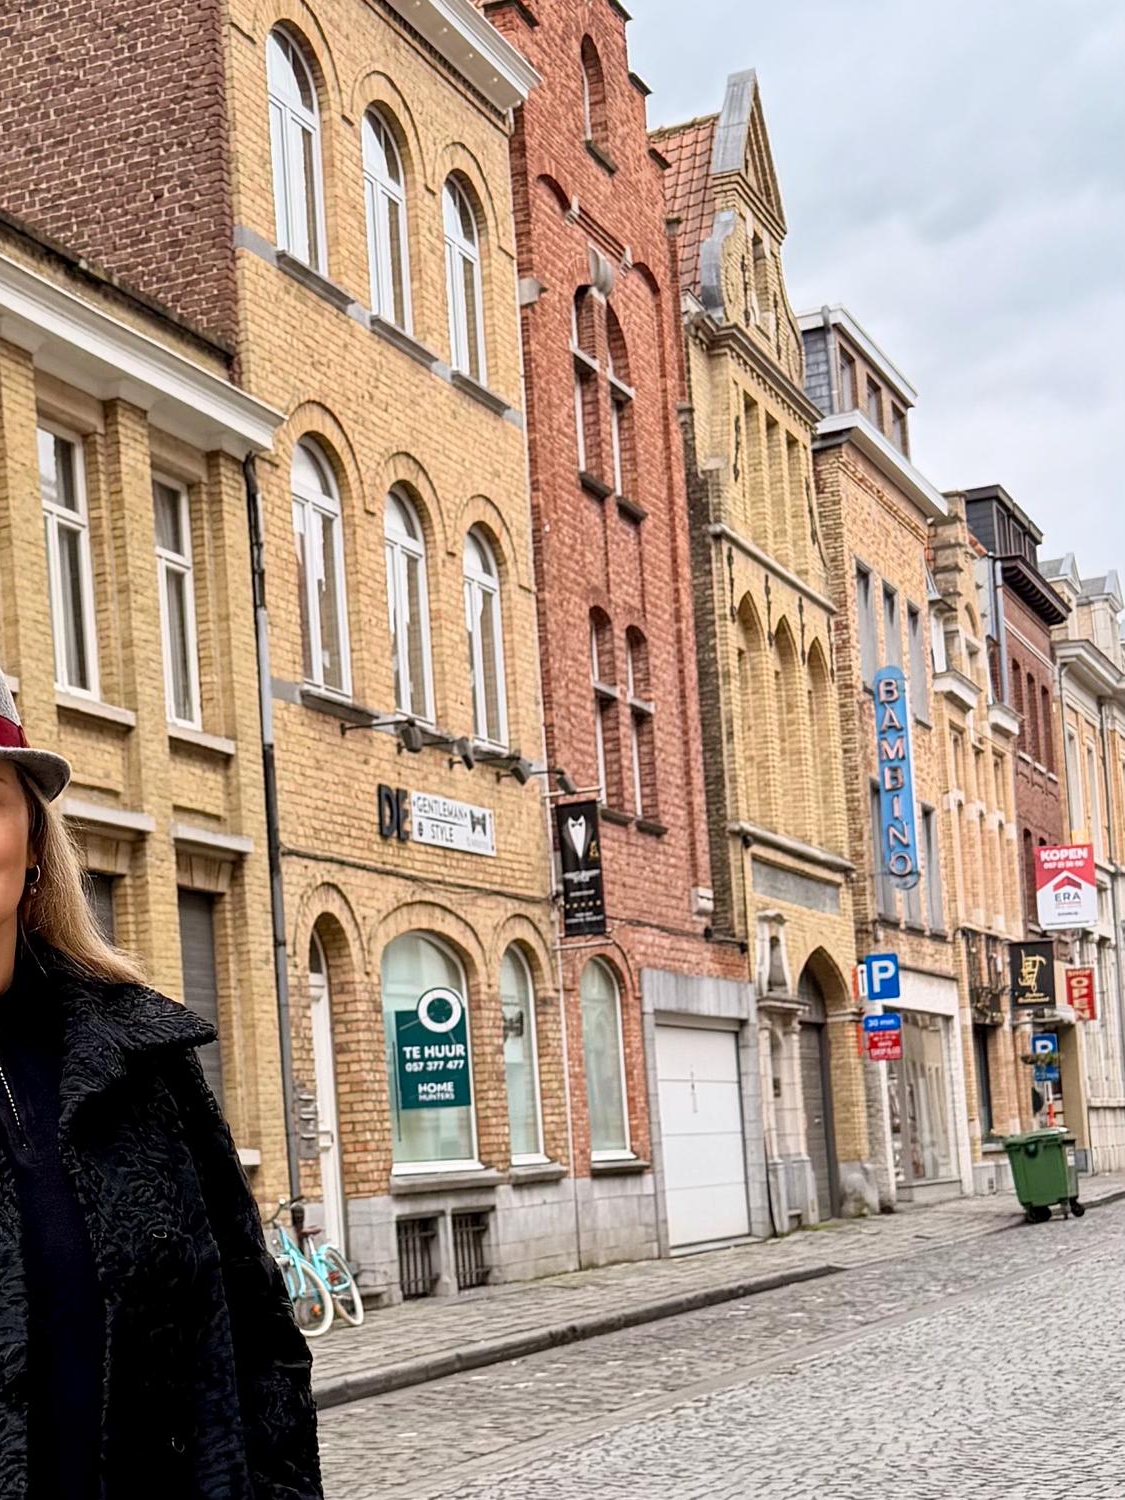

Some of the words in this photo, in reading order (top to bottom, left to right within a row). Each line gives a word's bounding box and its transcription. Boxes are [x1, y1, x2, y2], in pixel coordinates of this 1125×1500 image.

[878, 679, 911, 876] BAMBINO
[377, 783, 409, 842] DE
[416, 796, 465, 820] GENTLEMAN
[431, 823, 454, 843] STYLE
[1040, 847, 1088, 862] KOPEN
[1054, 891, 1081, 902] ERA
[871, 960, 896, 993] P
[1070, 976, 1091, 1021] OPEN
[403, 1046, 421, 1059] TE
[424, 1044, 465, 1058] HUUR
[405, 1061, 424, 1072] 057
[426, 1061, 444, 1071] 377
[446, 1060, 464, 1070] 477
[418, 1081, 454, 1093] HOME
[419, 1092, 455, 1101] HUNTERS
